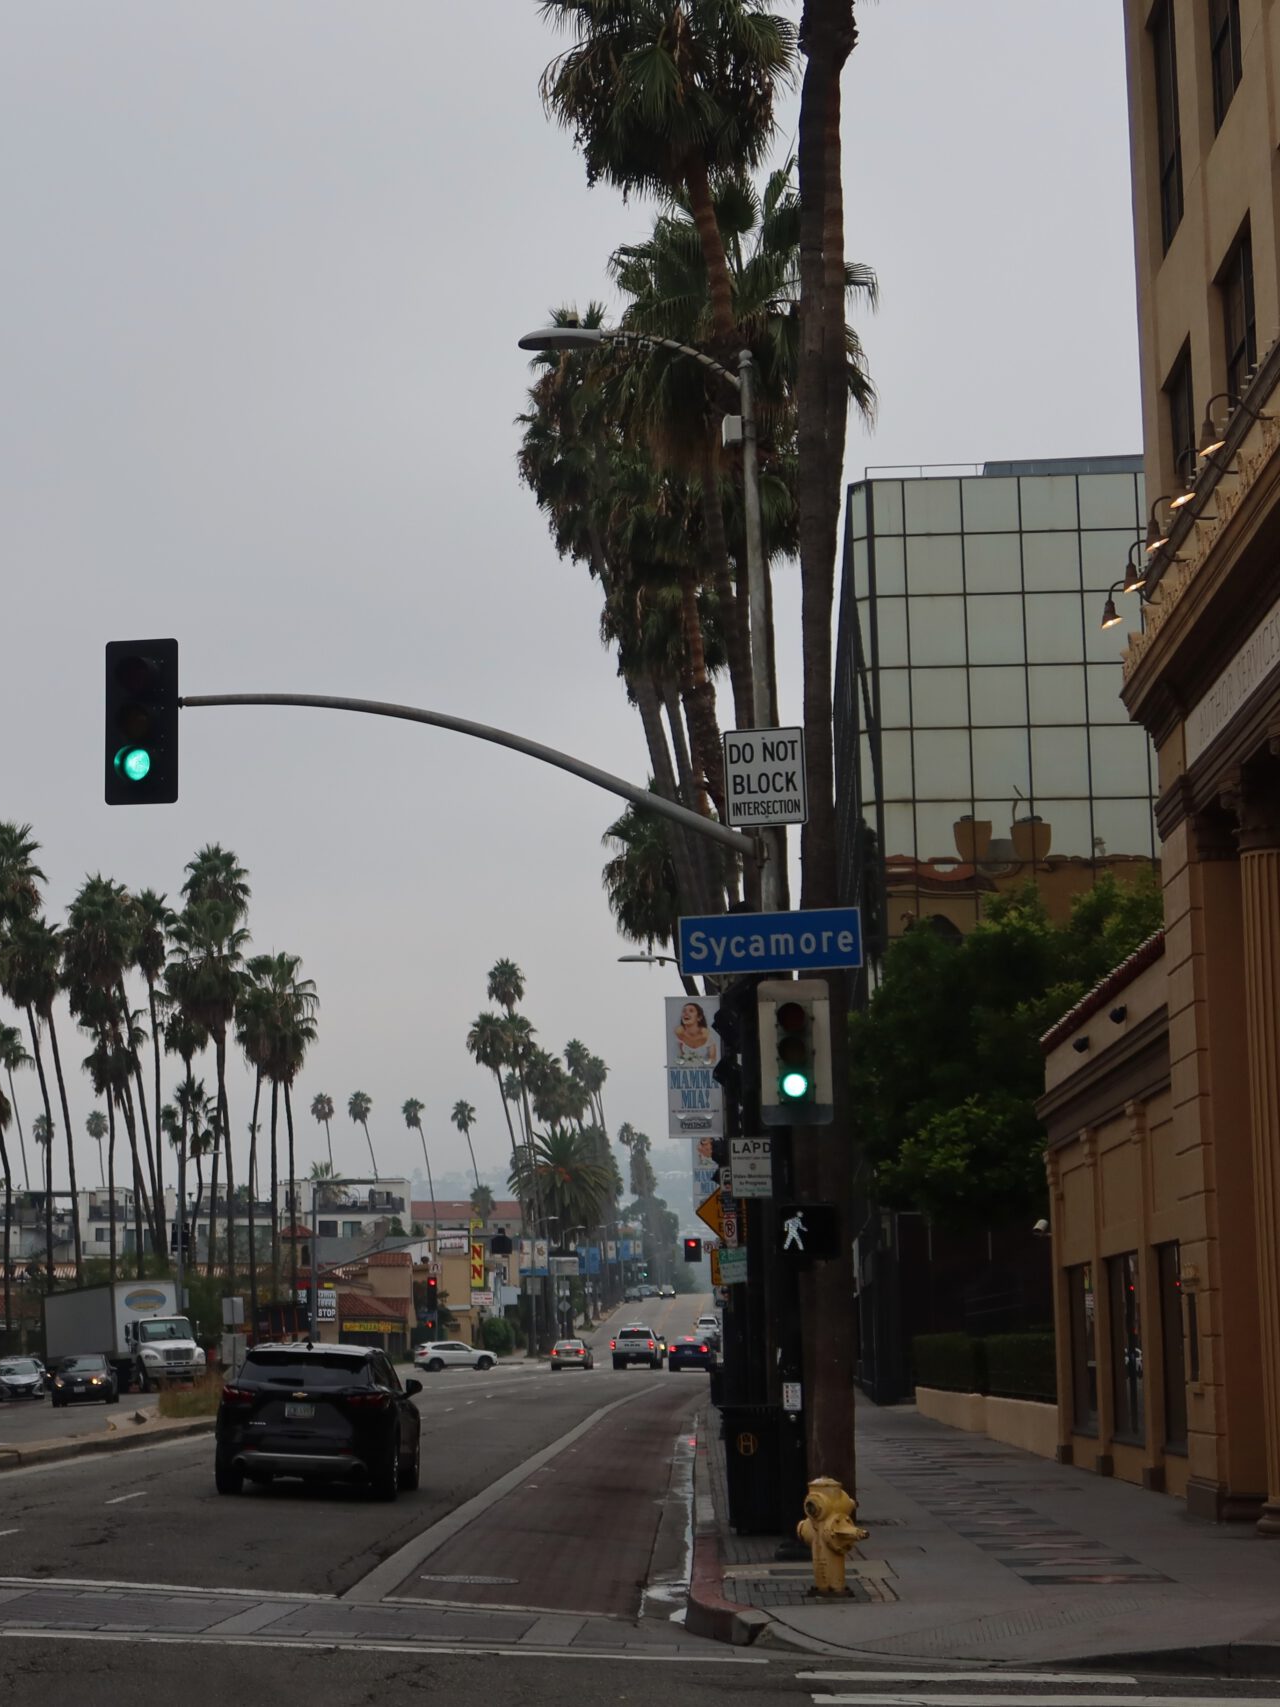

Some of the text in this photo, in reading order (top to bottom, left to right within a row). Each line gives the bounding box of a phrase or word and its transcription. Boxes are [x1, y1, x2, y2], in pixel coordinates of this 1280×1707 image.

[729, 740, 798, 764] DO NOT
[733, 771, 798, 795] BLOCK
[732, 799, 801, 817] INTERSECTION
[688, 930, 854, 967] Sycamore
[681, 1089, 711, 1109] MIA!
[732, 1142, 772, 1154] LAPD
[318, 1308, 336, 1317] STOP
